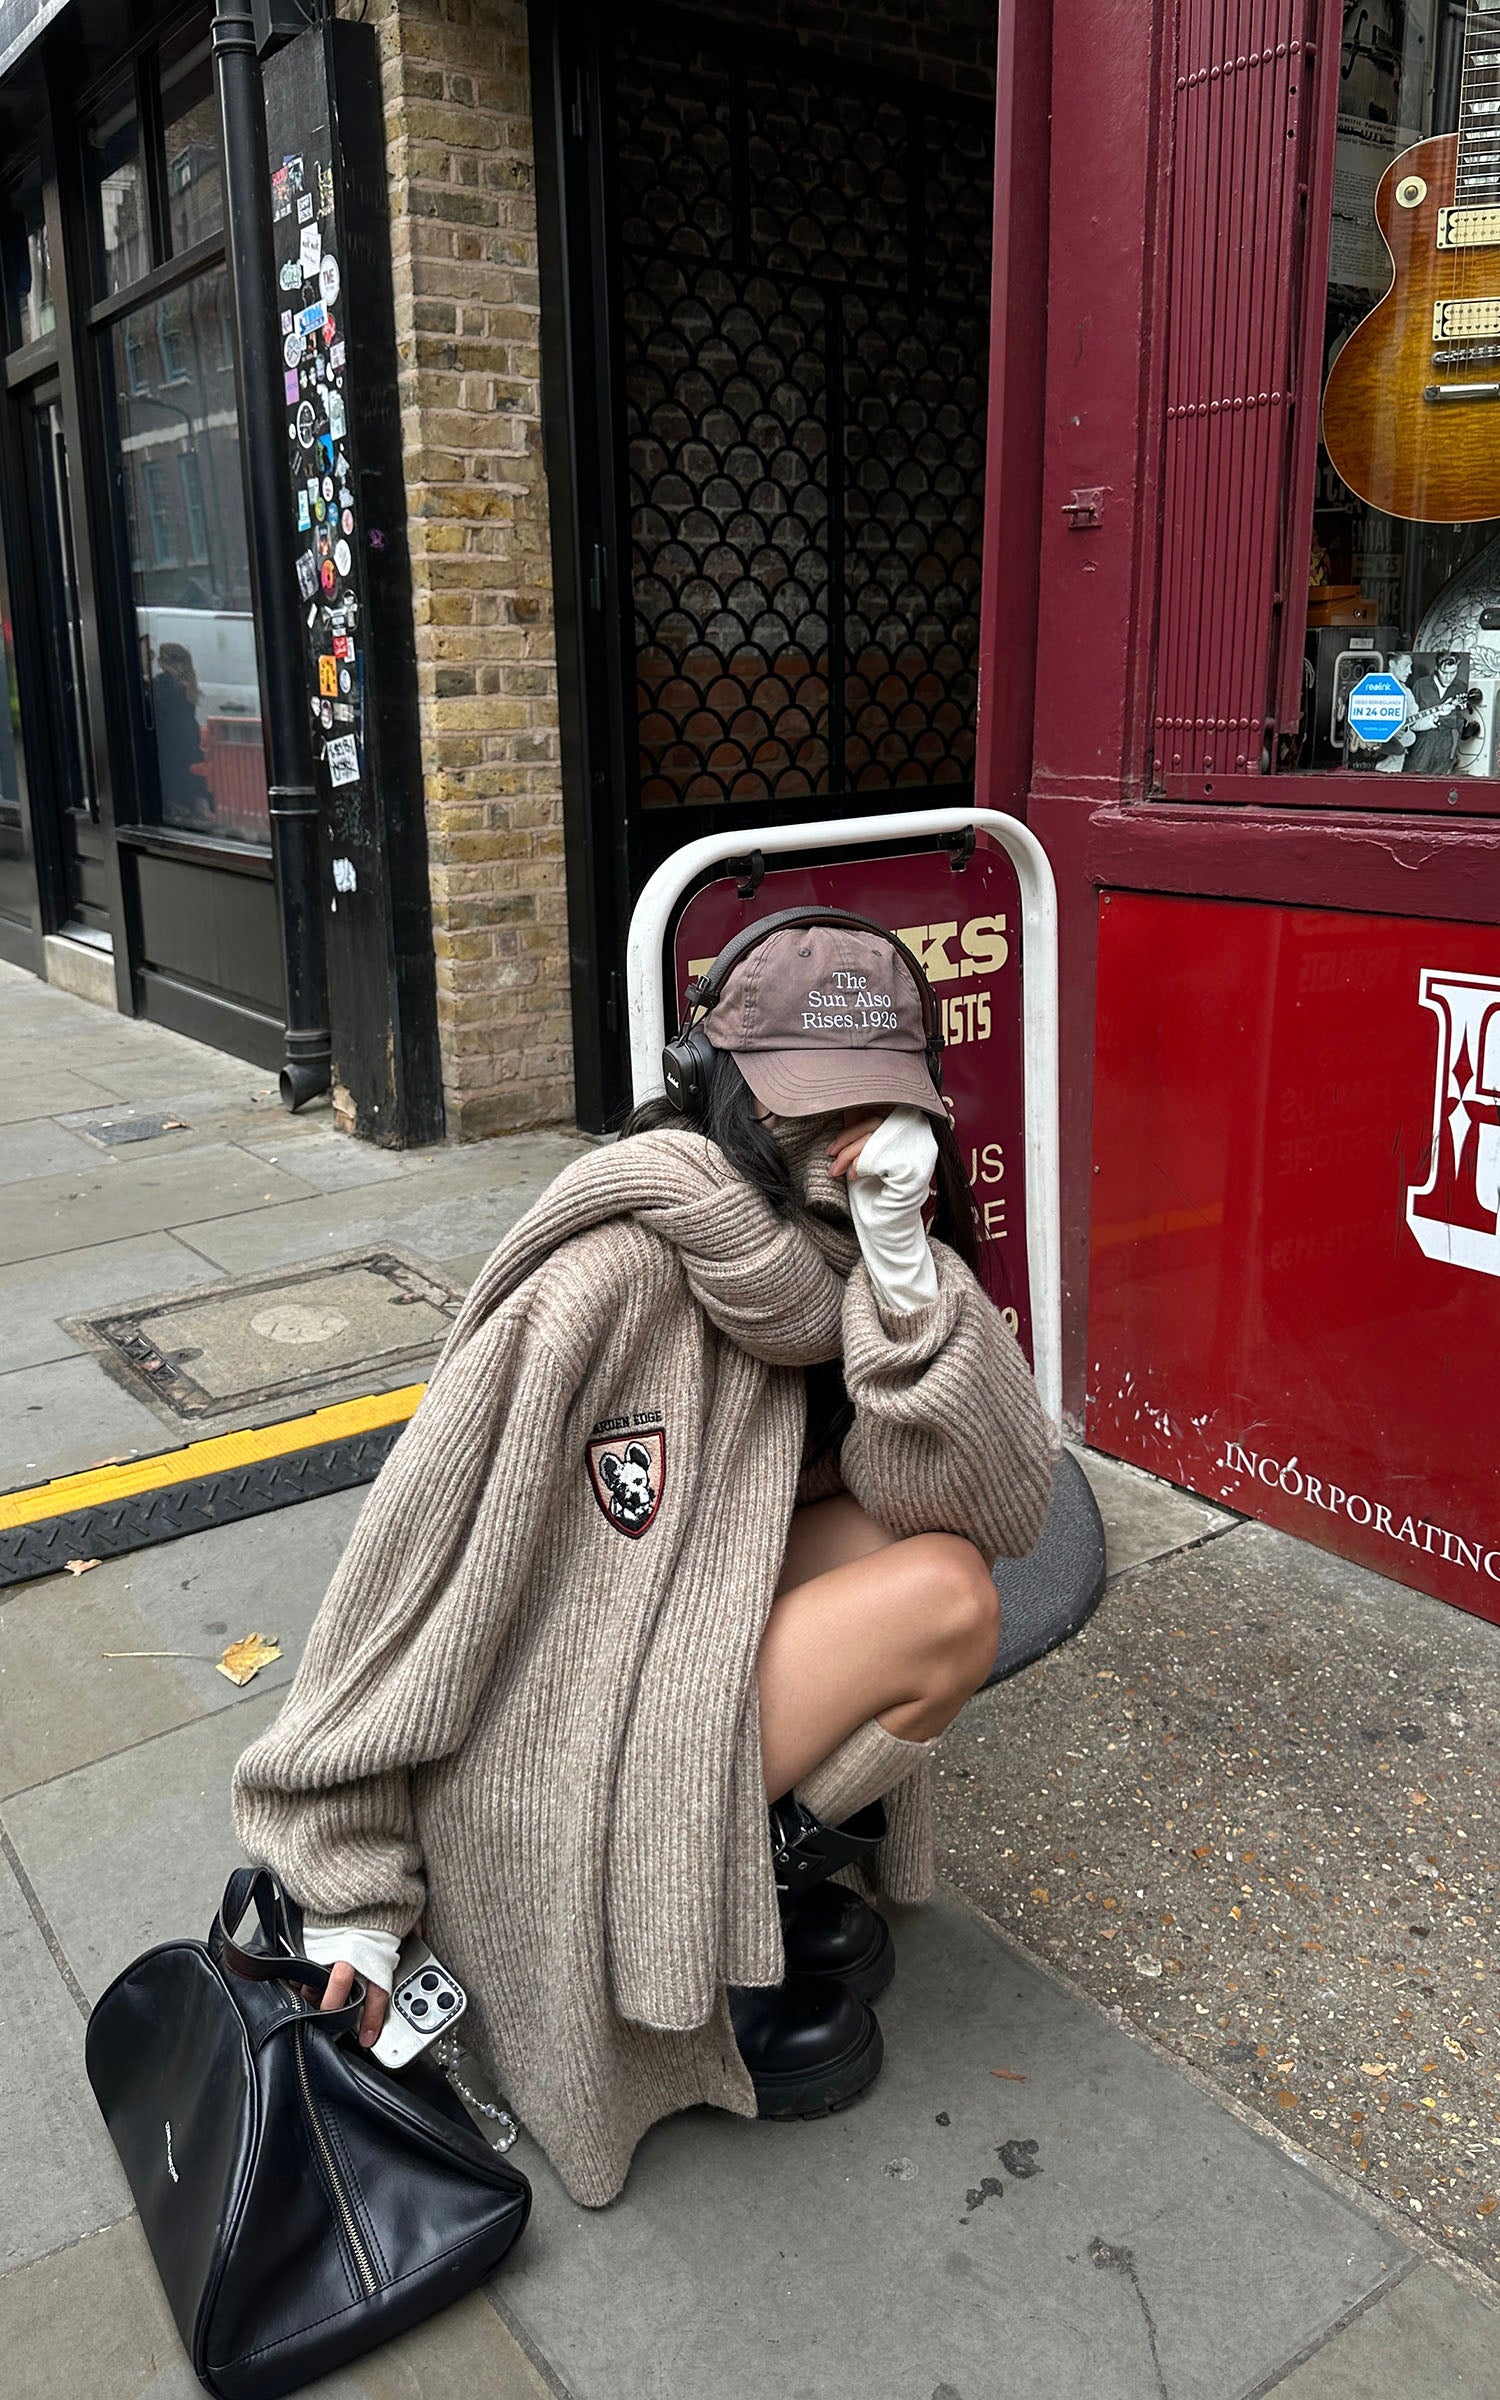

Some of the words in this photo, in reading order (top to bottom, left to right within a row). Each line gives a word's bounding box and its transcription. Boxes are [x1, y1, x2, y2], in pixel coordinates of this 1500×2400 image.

[1353, 707, 1363, 716] IN
[1366, 707, 1377, 716] 24
[1380, 707, 1401, 717] ORE
[898, 913, 1009, 984] KS
[832, 971, 867, 990] The
[808, 990, 848, 1008] Sun
[855, 991, 891, 1008] Also
[942, 991, 992, 1047] ISTS
[633, 1410, 662, 1426] EDGE
